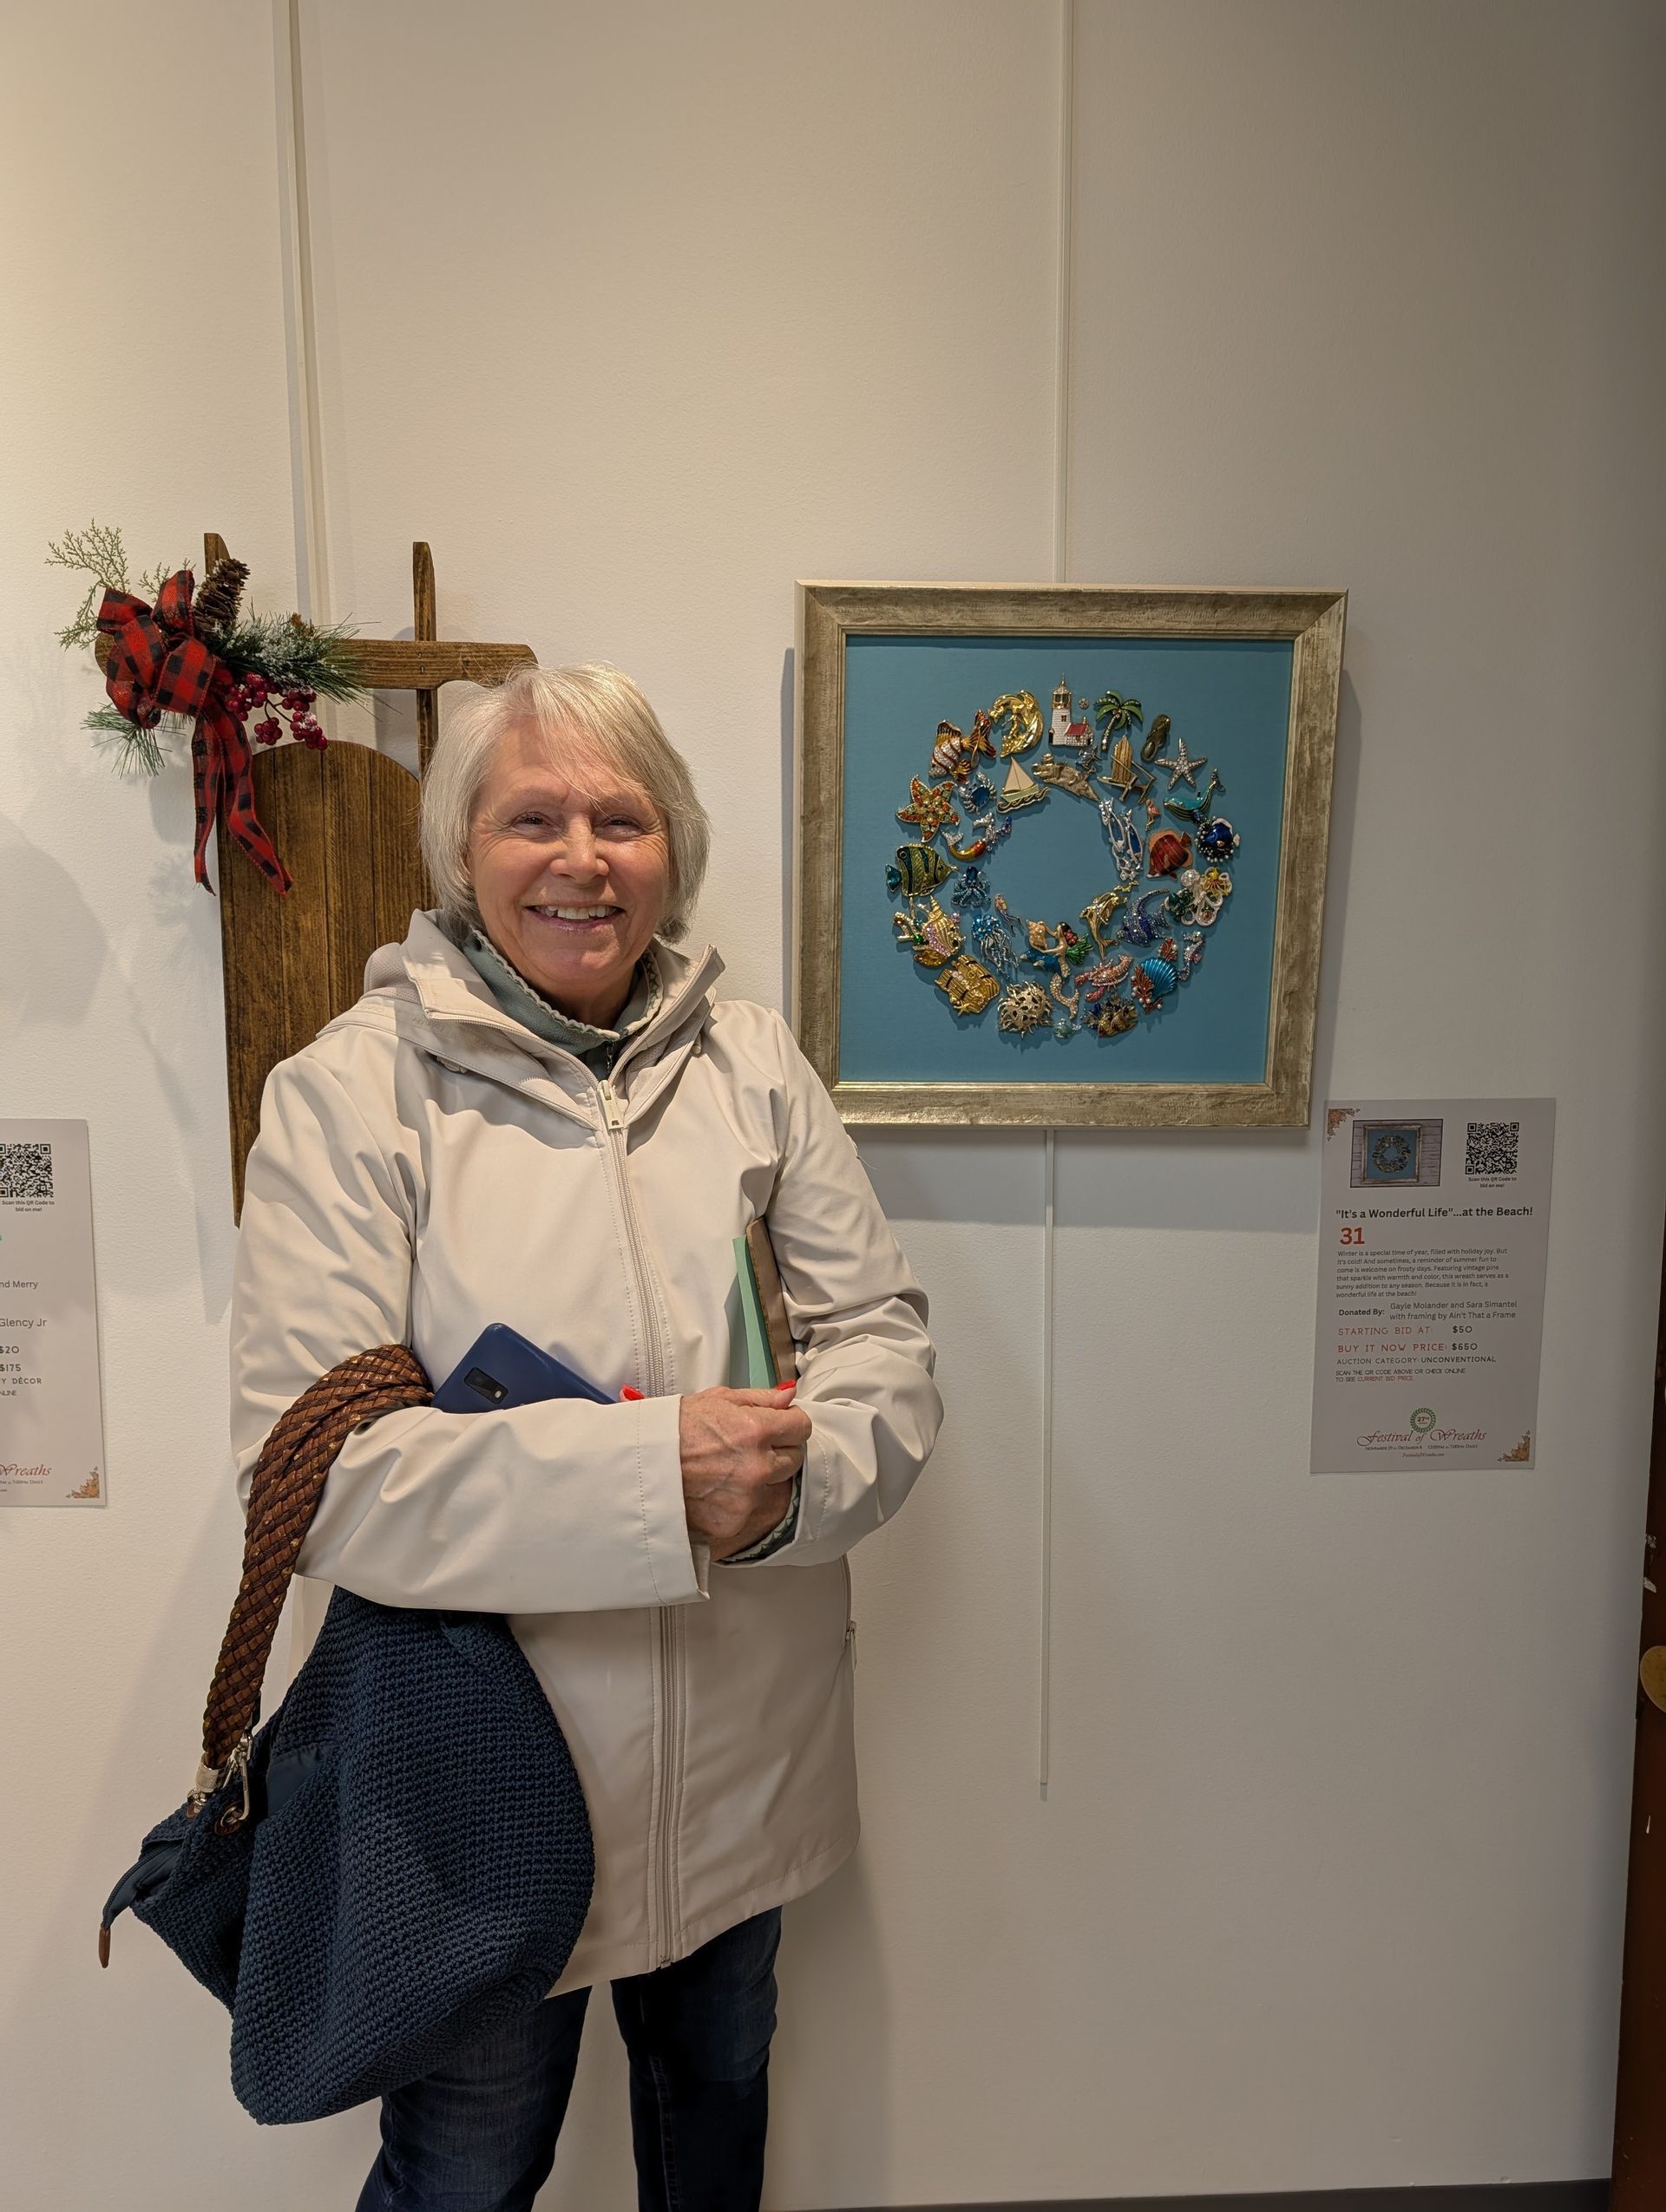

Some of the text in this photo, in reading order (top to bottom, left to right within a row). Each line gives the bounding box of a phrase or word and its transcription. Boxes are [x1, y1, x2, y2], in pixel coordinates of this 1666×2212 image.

[1336, 1209, 1356, 1218] "It's
[1369, 1208, 1425, 1218] Wonderful
[1428, 1207, 1473, 1217] Life"...at
[1496, 1207, 1532, 1215] Beach!
[1340, 1227, 1365, 1244] 31
[0, 1319, 34, 1329] Glency
[1357, 1429, 1487, 1446] Festival of Wreaths
